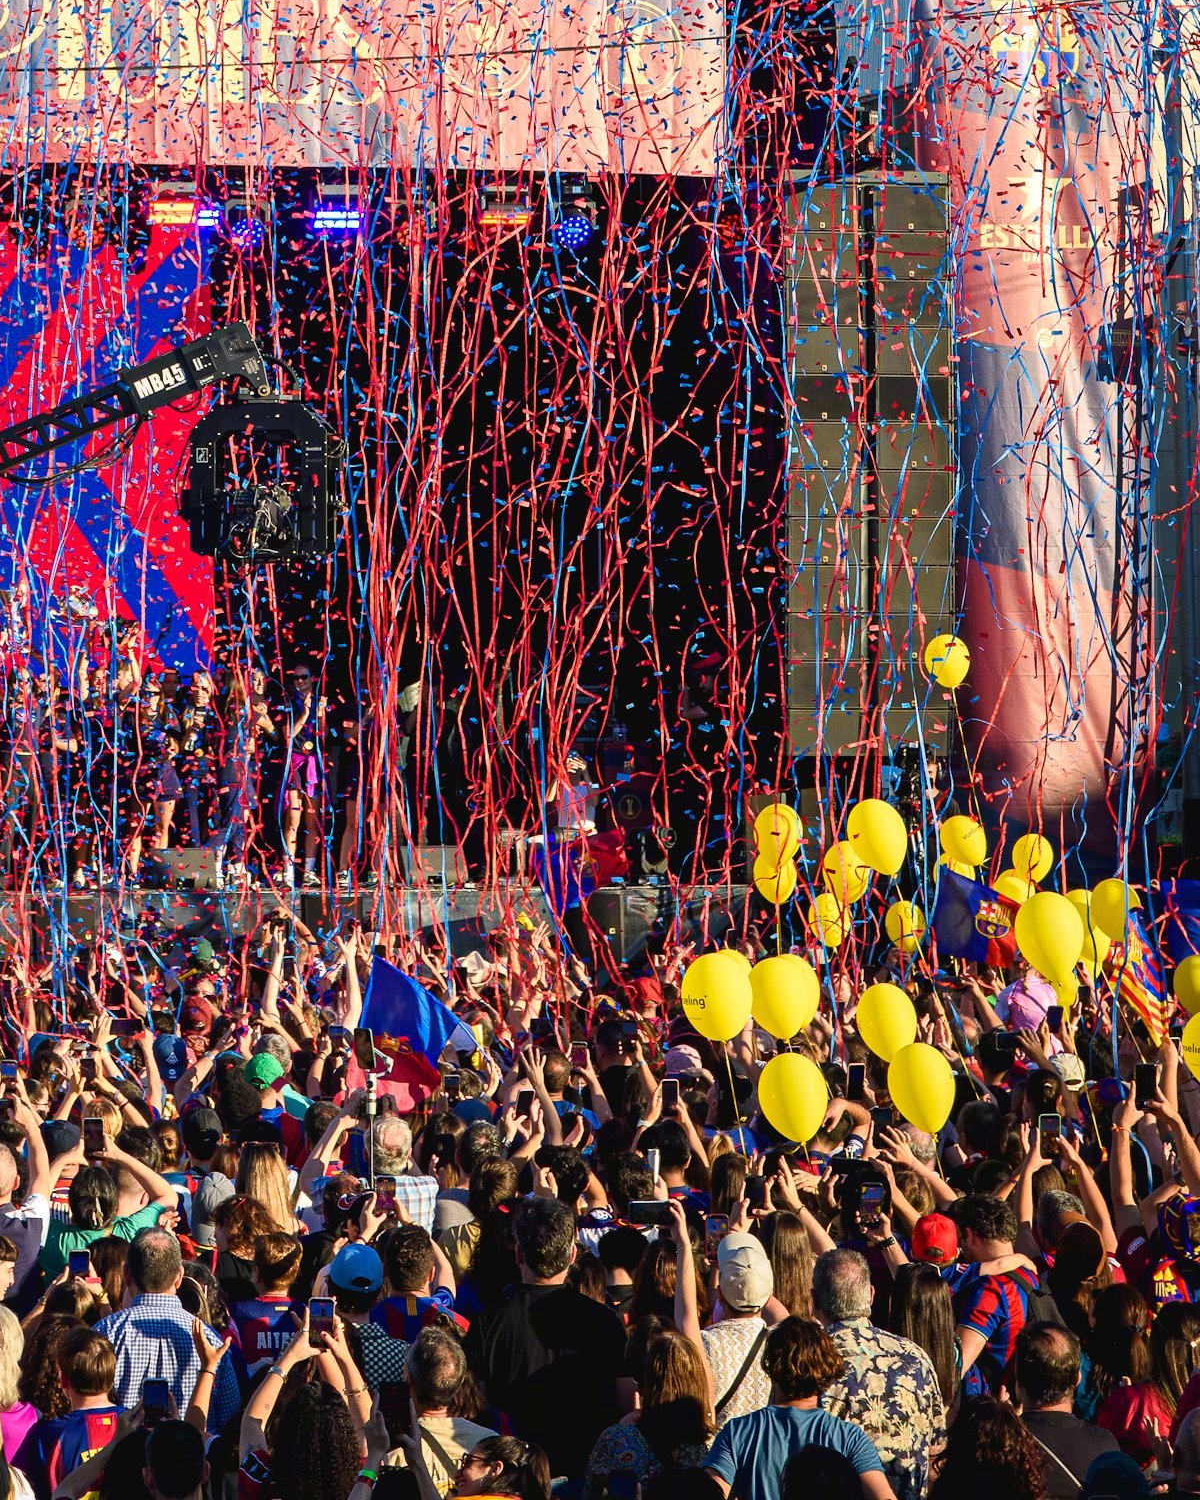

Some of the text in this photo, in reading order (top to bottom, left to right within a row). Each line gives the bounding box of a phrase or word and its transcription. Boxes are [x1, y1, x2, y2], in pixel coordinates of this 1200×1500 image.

[133, 362, 187, 400] MB45
[682, 994, 706, 1010] ueling
[257, 1331, 297, 1350] AITA
